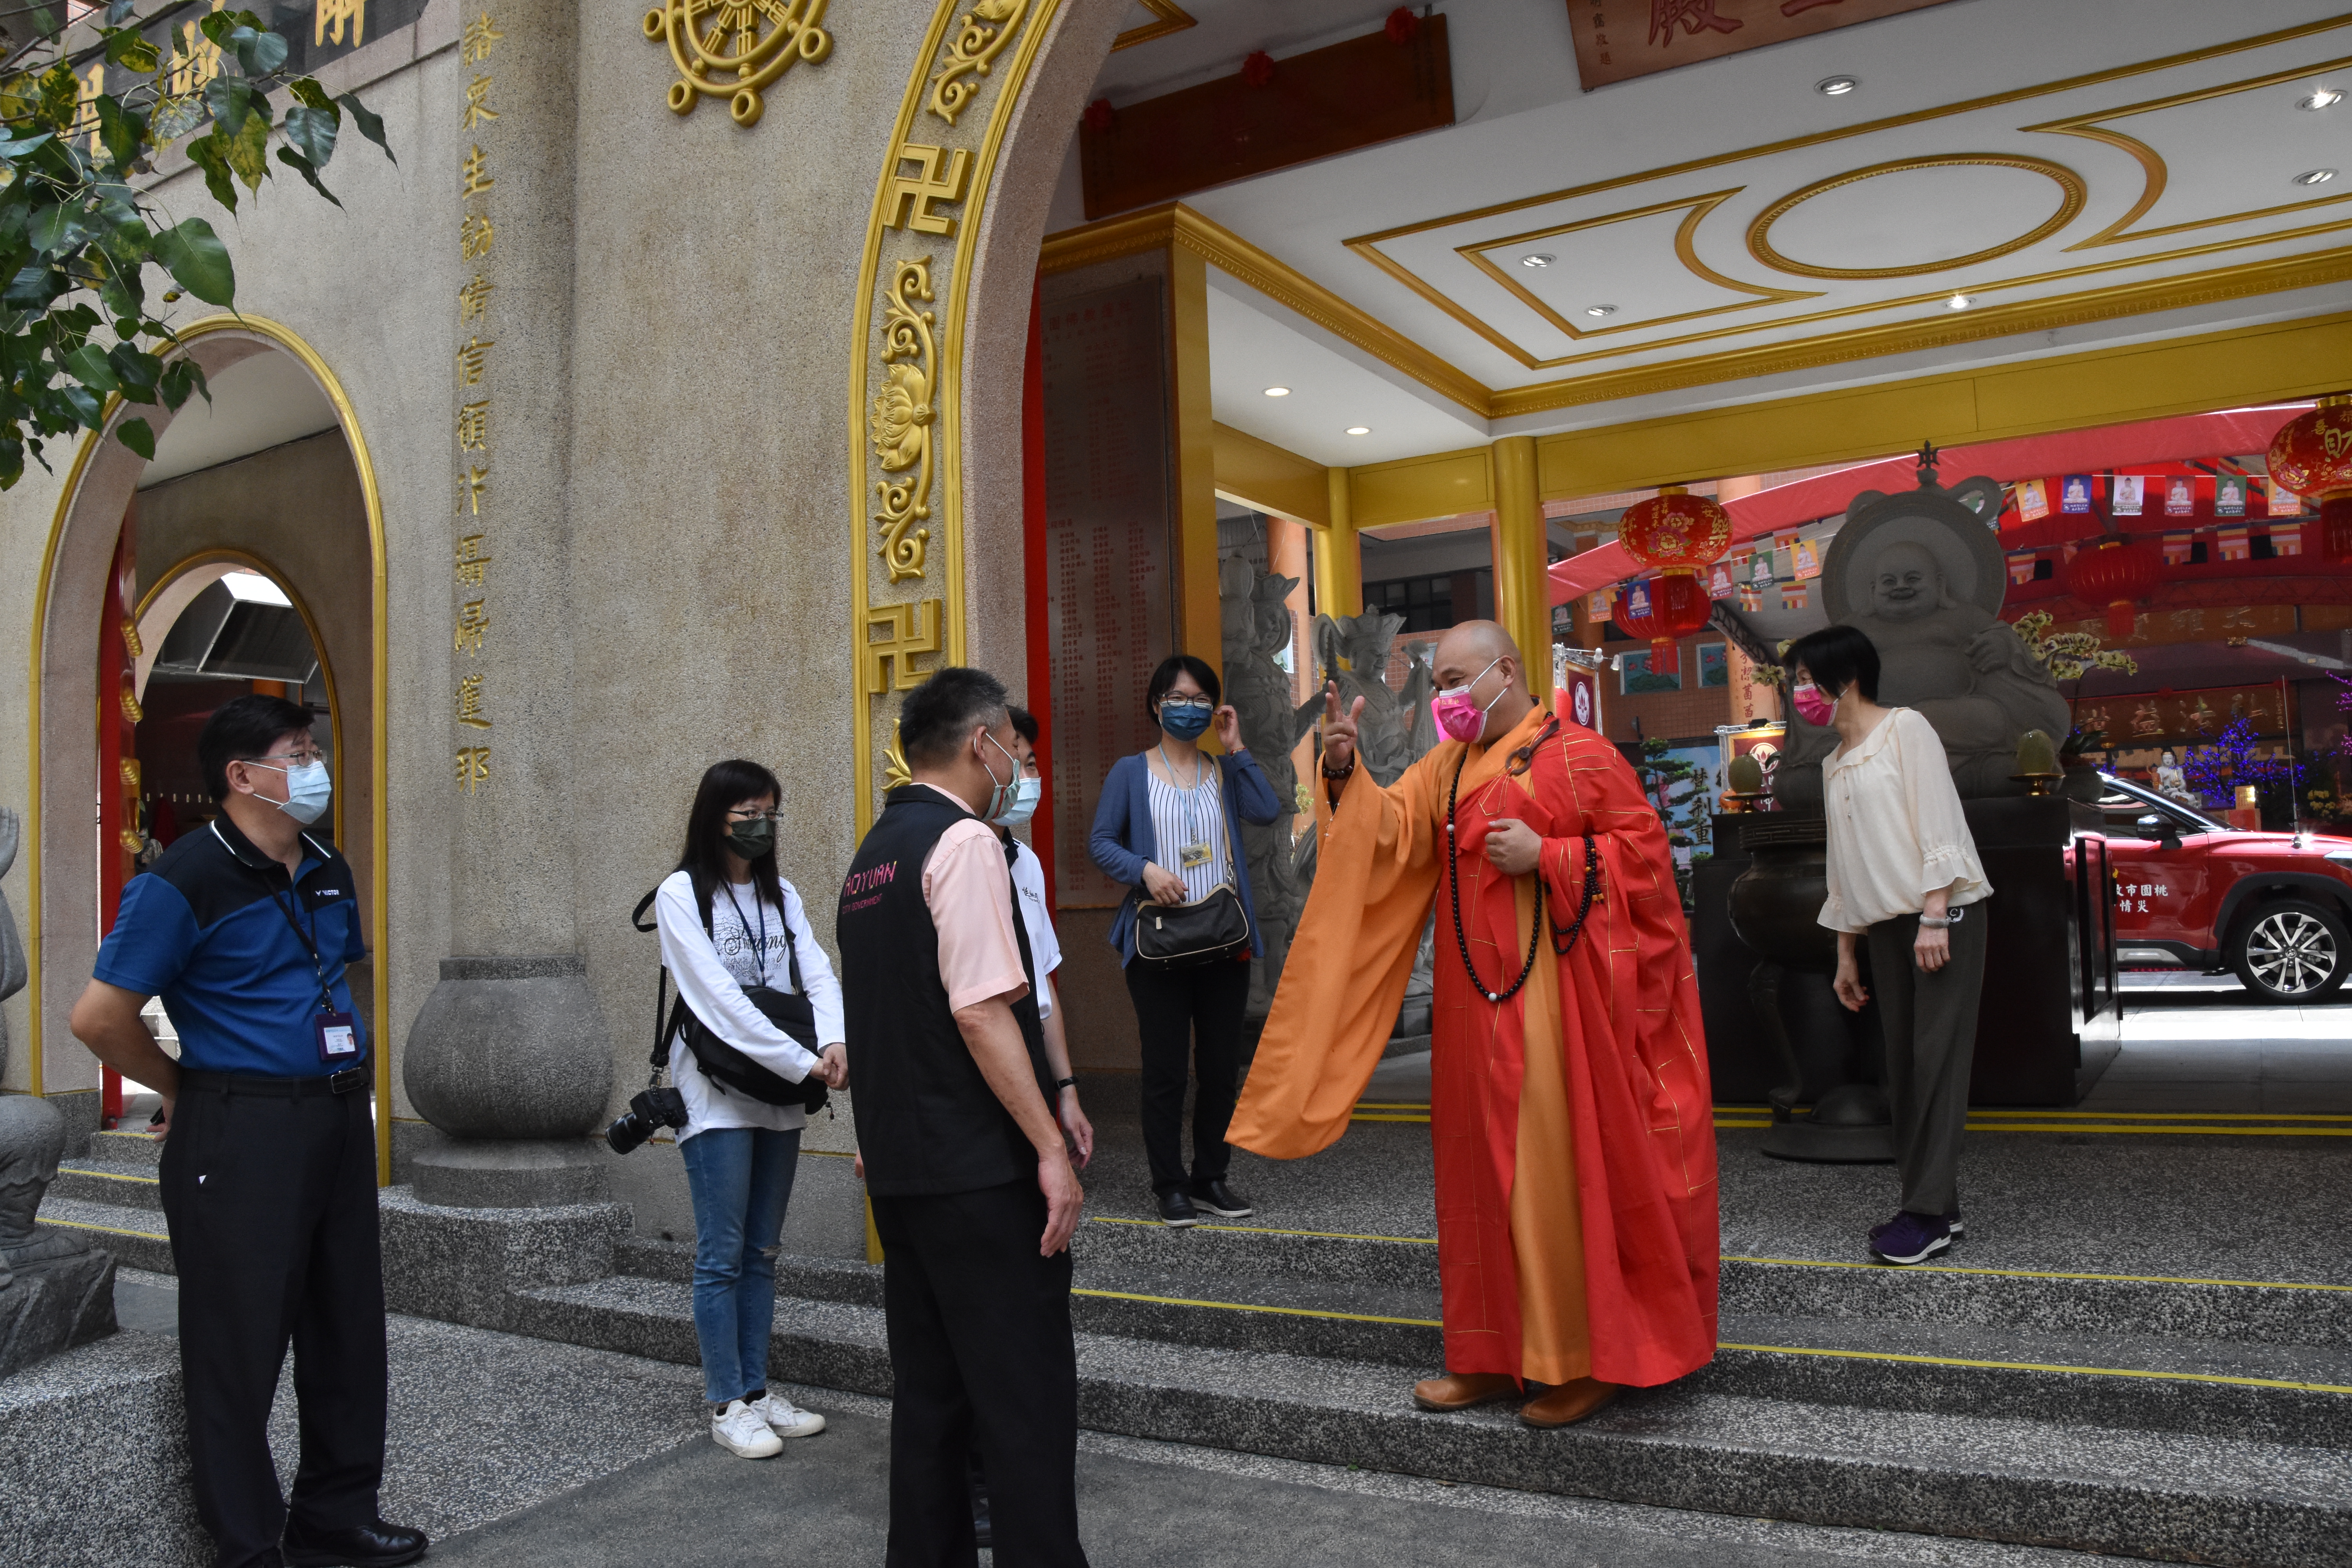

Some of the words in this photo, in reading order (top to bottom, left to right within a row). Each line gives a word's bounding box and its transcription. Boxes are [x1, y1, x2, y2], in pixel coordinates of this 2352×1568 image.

[1040, 299, 1132, 333] 園佛教蓮社
[851, 893, 883, 911] GOVERNMENT
